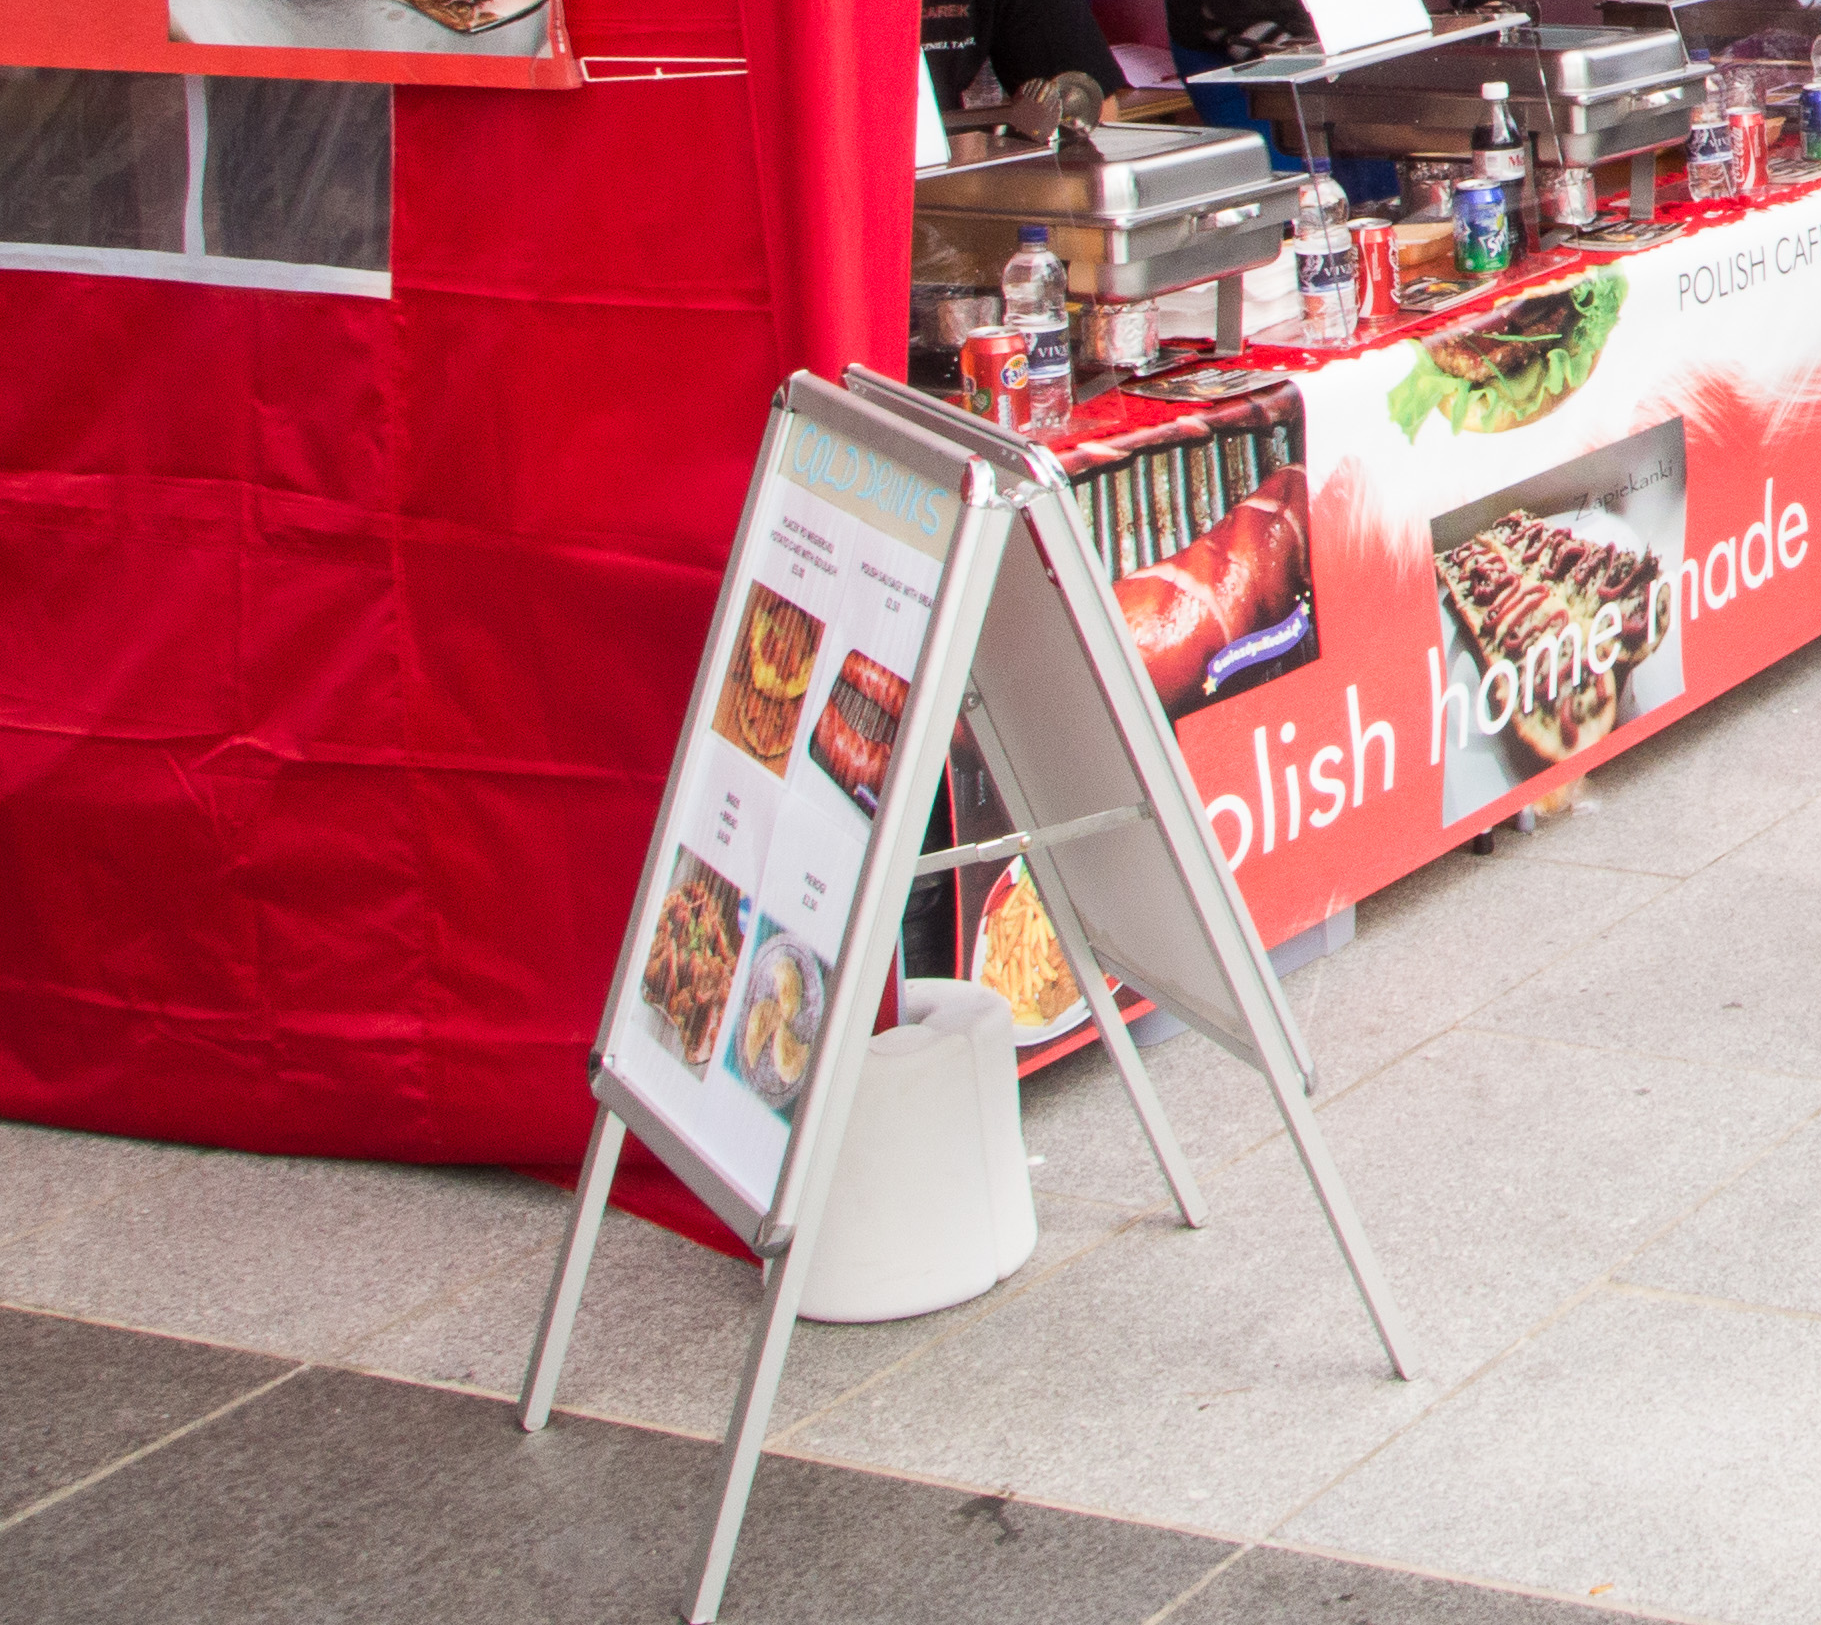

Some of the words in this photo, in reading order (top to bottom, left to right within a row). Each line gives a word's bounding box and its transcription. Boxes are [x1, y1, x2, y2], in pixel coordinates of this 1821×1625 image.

[1678, 245, 1766, 312] POLISH
[793, 423, 860, 492] COLD
[856, 451, 948, 536] DRINKS
[1575, 459, 1674, 523] Zapiekanki
[1204, 683, 1396, 873] olish
[1427, 602, 1624, 766] home
[1646, 478, 1810, 645] made
